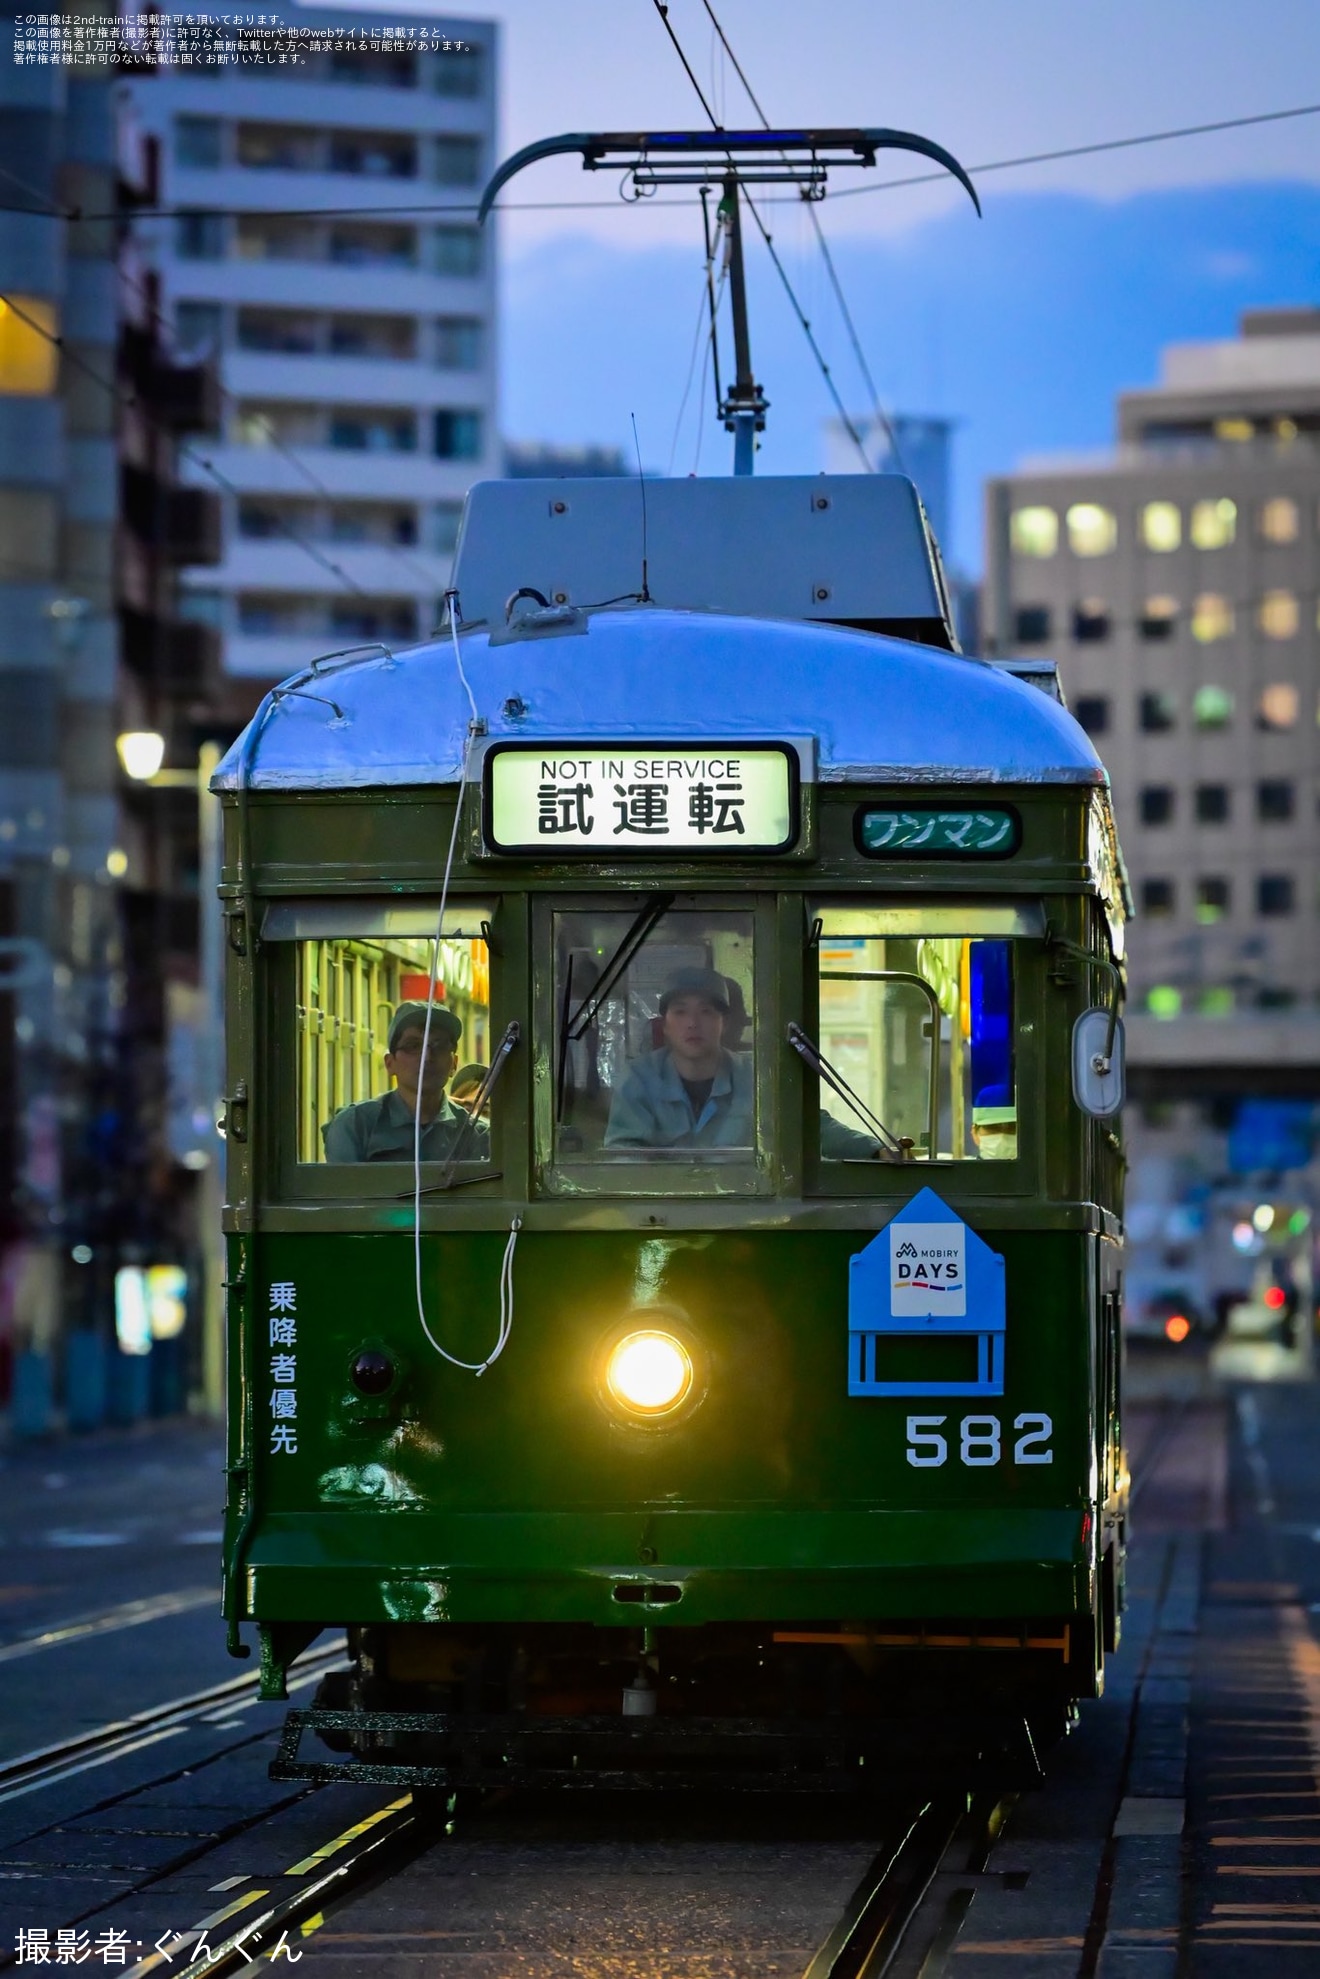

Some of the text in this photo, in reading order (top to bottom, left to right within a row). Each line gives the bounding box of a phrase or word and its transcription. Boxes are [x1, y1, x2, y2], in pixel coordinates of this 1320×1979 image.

[541, 760, 740, 779] NOT IN SERVICE
[537, 782, 745, 835] 試運転
[865, 814, 1010, 848] ワンマン
[921, 1249, 959, 1258] MOBIRY
[898, 1263, 959, 1279] DAYS
[269, 1282, 298, 1454] 乗降者優先
[906, 1413, 1053, 1467] 582
